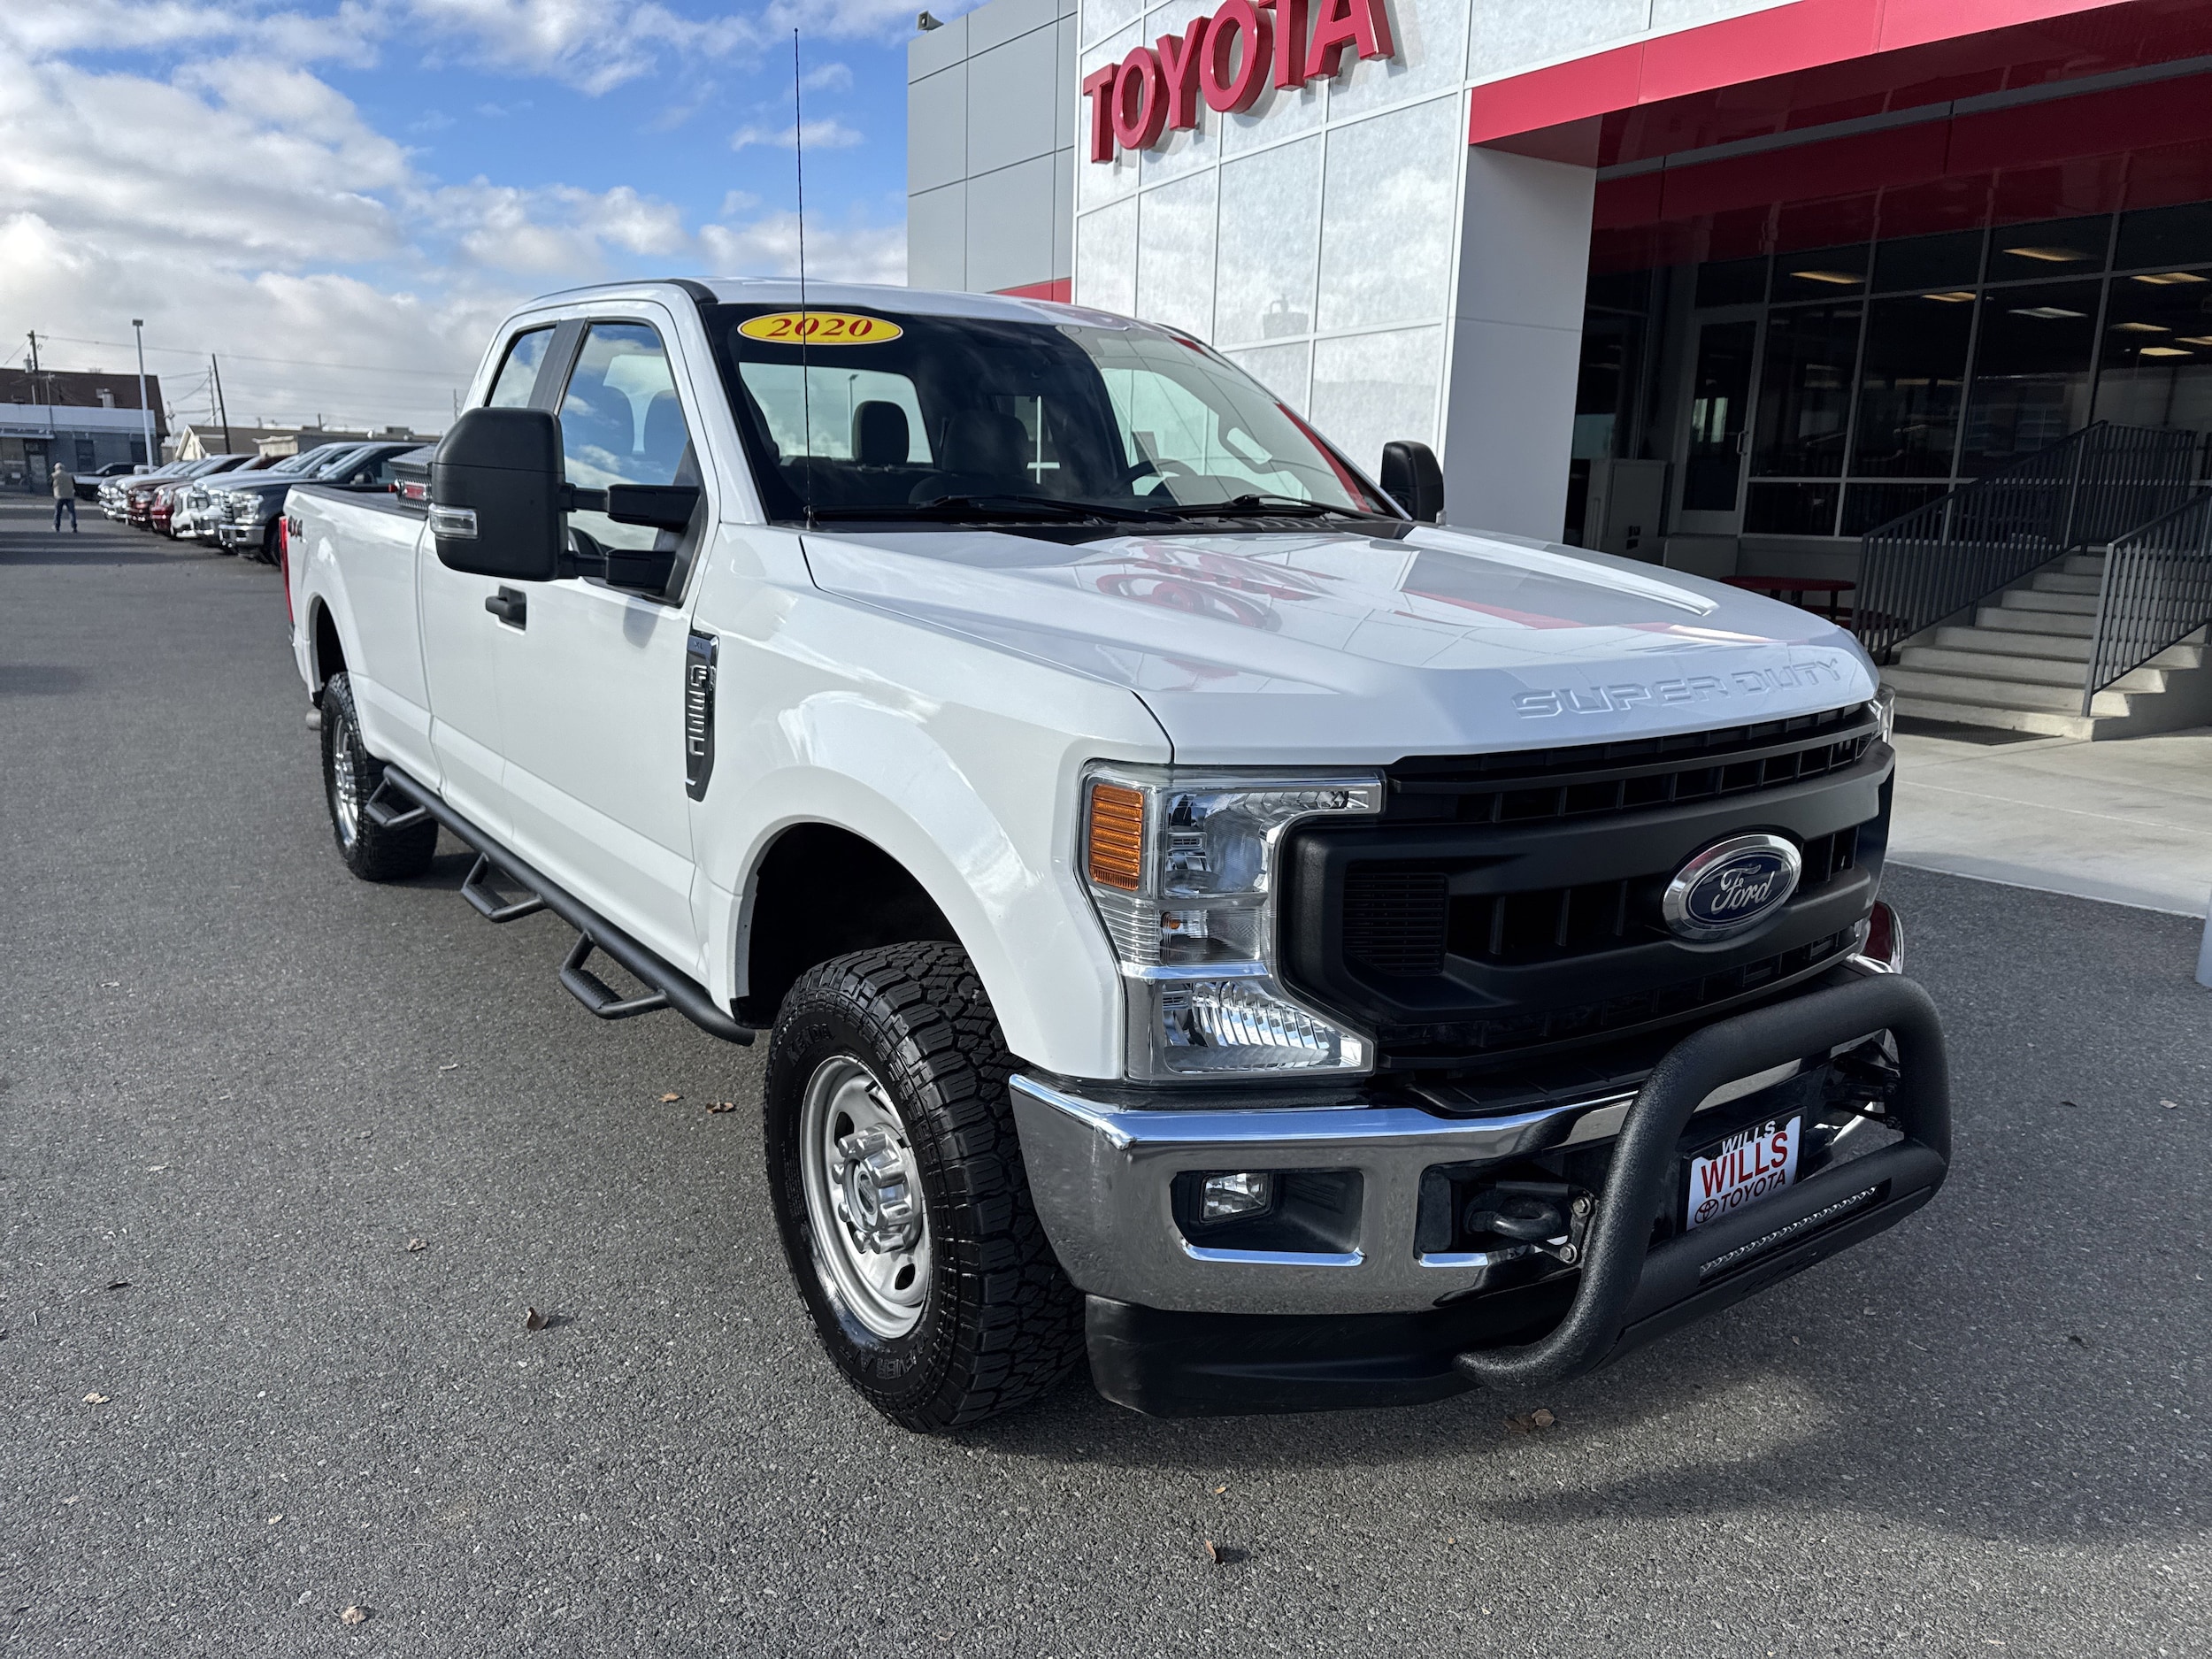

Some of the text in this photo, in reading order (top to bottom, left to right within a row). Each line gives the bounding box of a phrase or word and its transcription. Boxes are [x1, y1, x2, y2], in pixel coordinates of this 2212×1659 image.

[1083, 0, 1394, 165] TOYOTA
[765, 318, 872, 336] 2020
[1511, 657, 1841, 719] SUPER DUTY
[1710, 864, 1776, 915] Ford
[1722, 1121, 1777, 1154] WILLS
[1701, 1132, 1788, 1198] WILLS
[1721, 1169, 1786, 1212] TOYOTA
